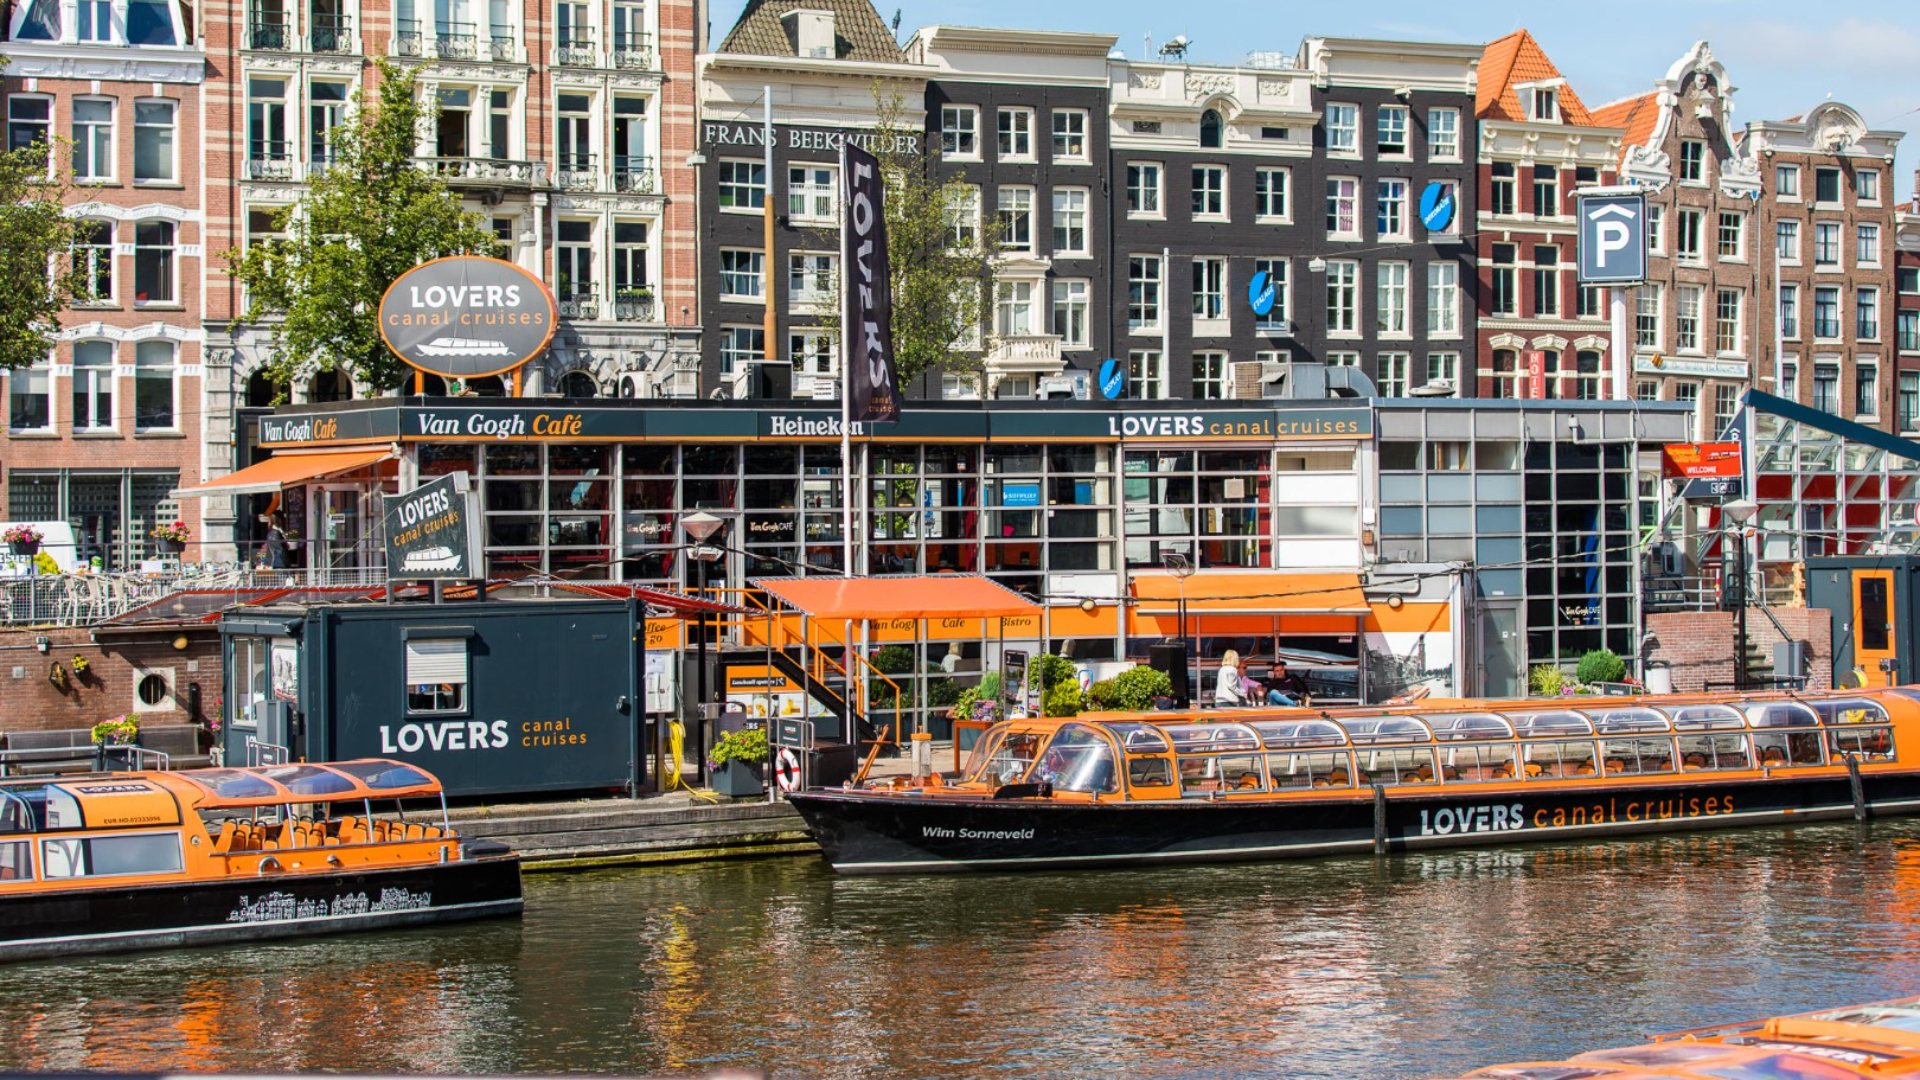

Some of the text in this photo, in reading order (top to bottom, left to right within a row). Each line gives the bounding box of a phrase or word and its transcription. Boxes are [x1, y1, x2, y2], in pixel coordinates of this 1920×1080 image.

[704, 124, 920, 155] FRANS BEEKWILDER
[1598, 221, 1629, 268] P
[852, 161, 891, 389] LOVERS
[411, 285, 521, 308] LOVERS
[389, 310, 543, 325] canal cruises
[1530, 352, 1539, 399] HOTE
[265, 417, 337, 443] Van Gogh Café
[418, 413, 583, 439] Van Gogh Café
[1108, 416, 1358, 436] LOVERS canal cruises
[1686, 465, 1717, 474] WELCOME
[397, 487, 449, 529] LOVERS
[393, 509, 459, 547] canal cruises
[644, 622, 666, 633] ffee
[1001, 617, 1031, 627] Bistro
[379, 717, 570, 753] LOVERS canal
[522, 732, 587, 747] cruises
[1420, 793, 1735, 836] LOVERS canal cruises
[922, 826, 1035, 839] Wim Sonneveld
